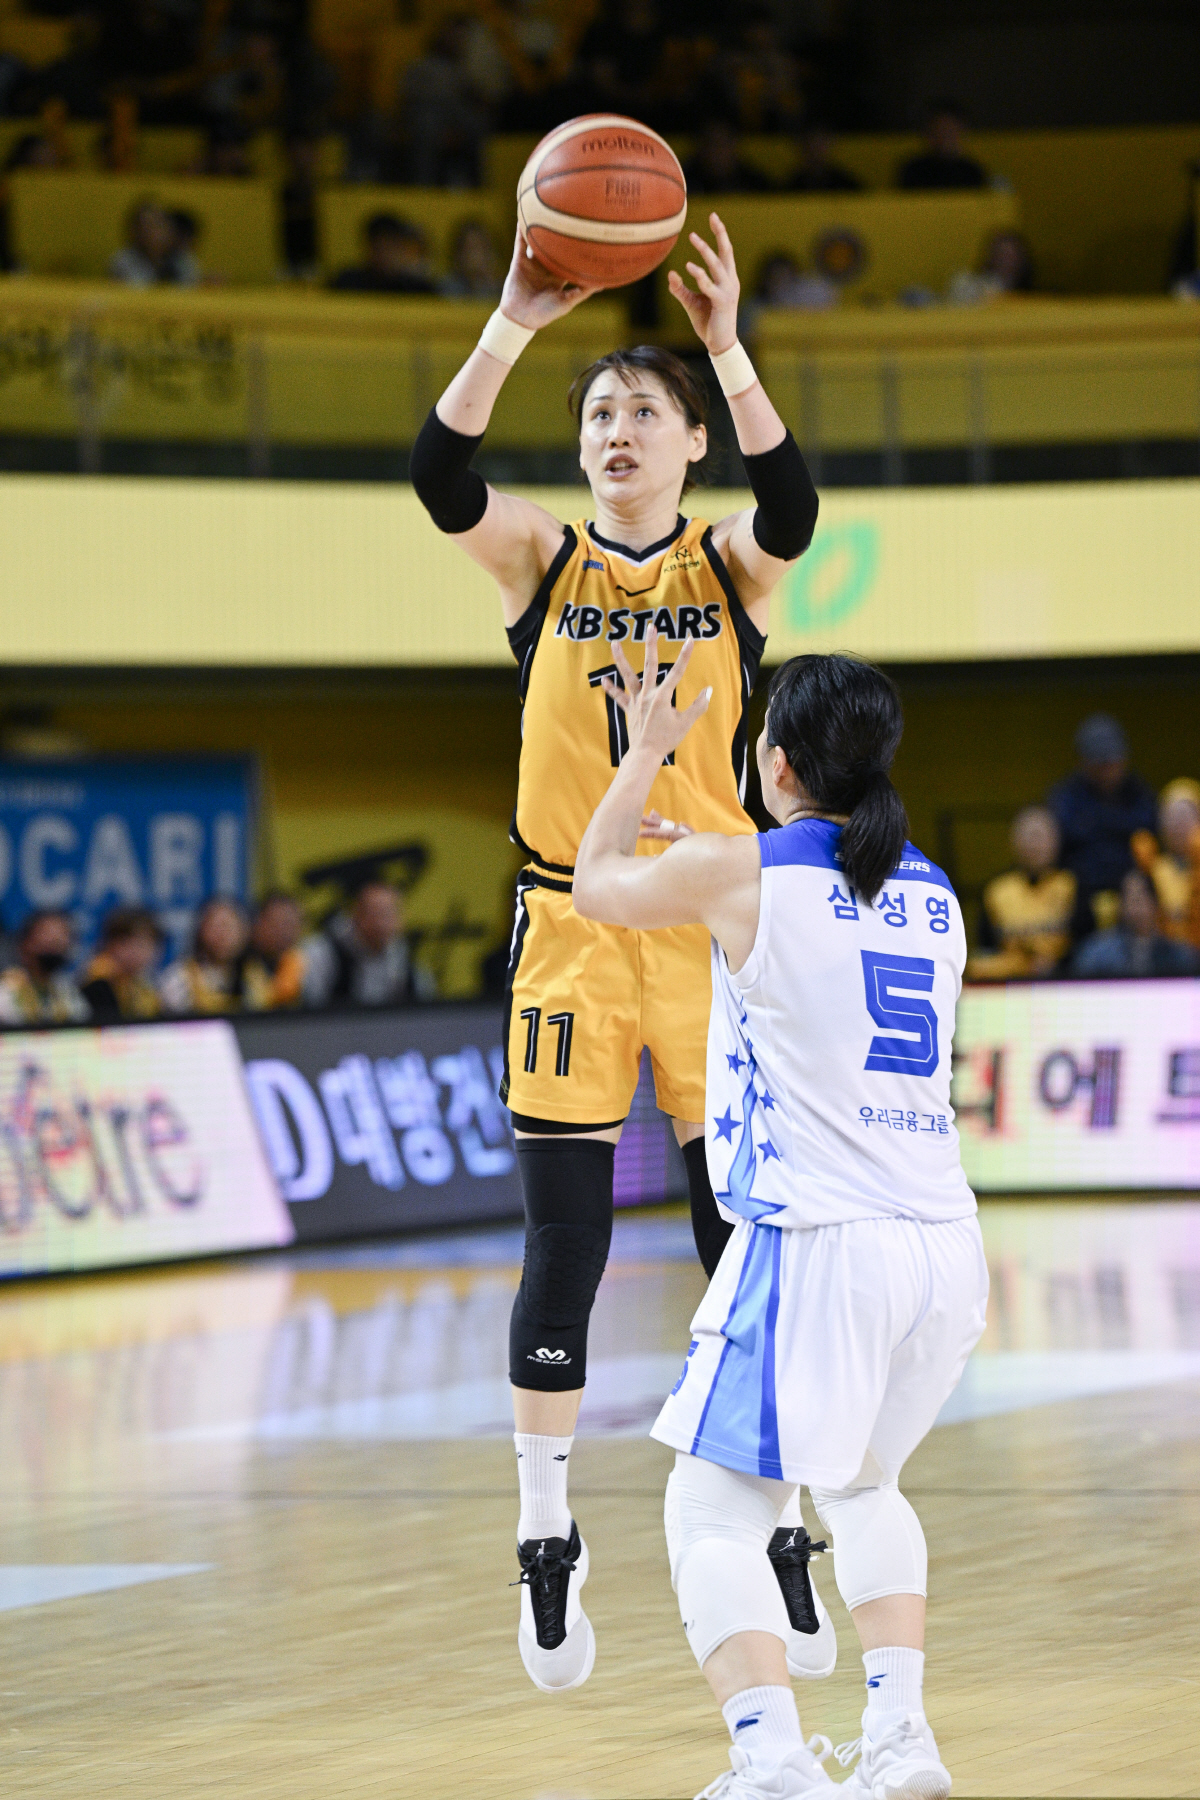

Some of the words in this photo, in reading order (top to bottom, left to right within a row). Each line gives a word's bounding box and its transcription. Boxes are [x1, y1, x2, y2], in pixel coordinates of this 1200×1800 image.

[581, 134, 655, 157] molten
[554, 602, 602, 641] KB
[606, 602, 721, 641] STARS
[0, 811, 241, 910] CARI
[520, 1006, 575, 1077] 11
[860, 949, 940, 1078] 5
[317, 1045, 514, 1192] 대방건
[858, 1106, 949, 1135] 우리금융그룹
